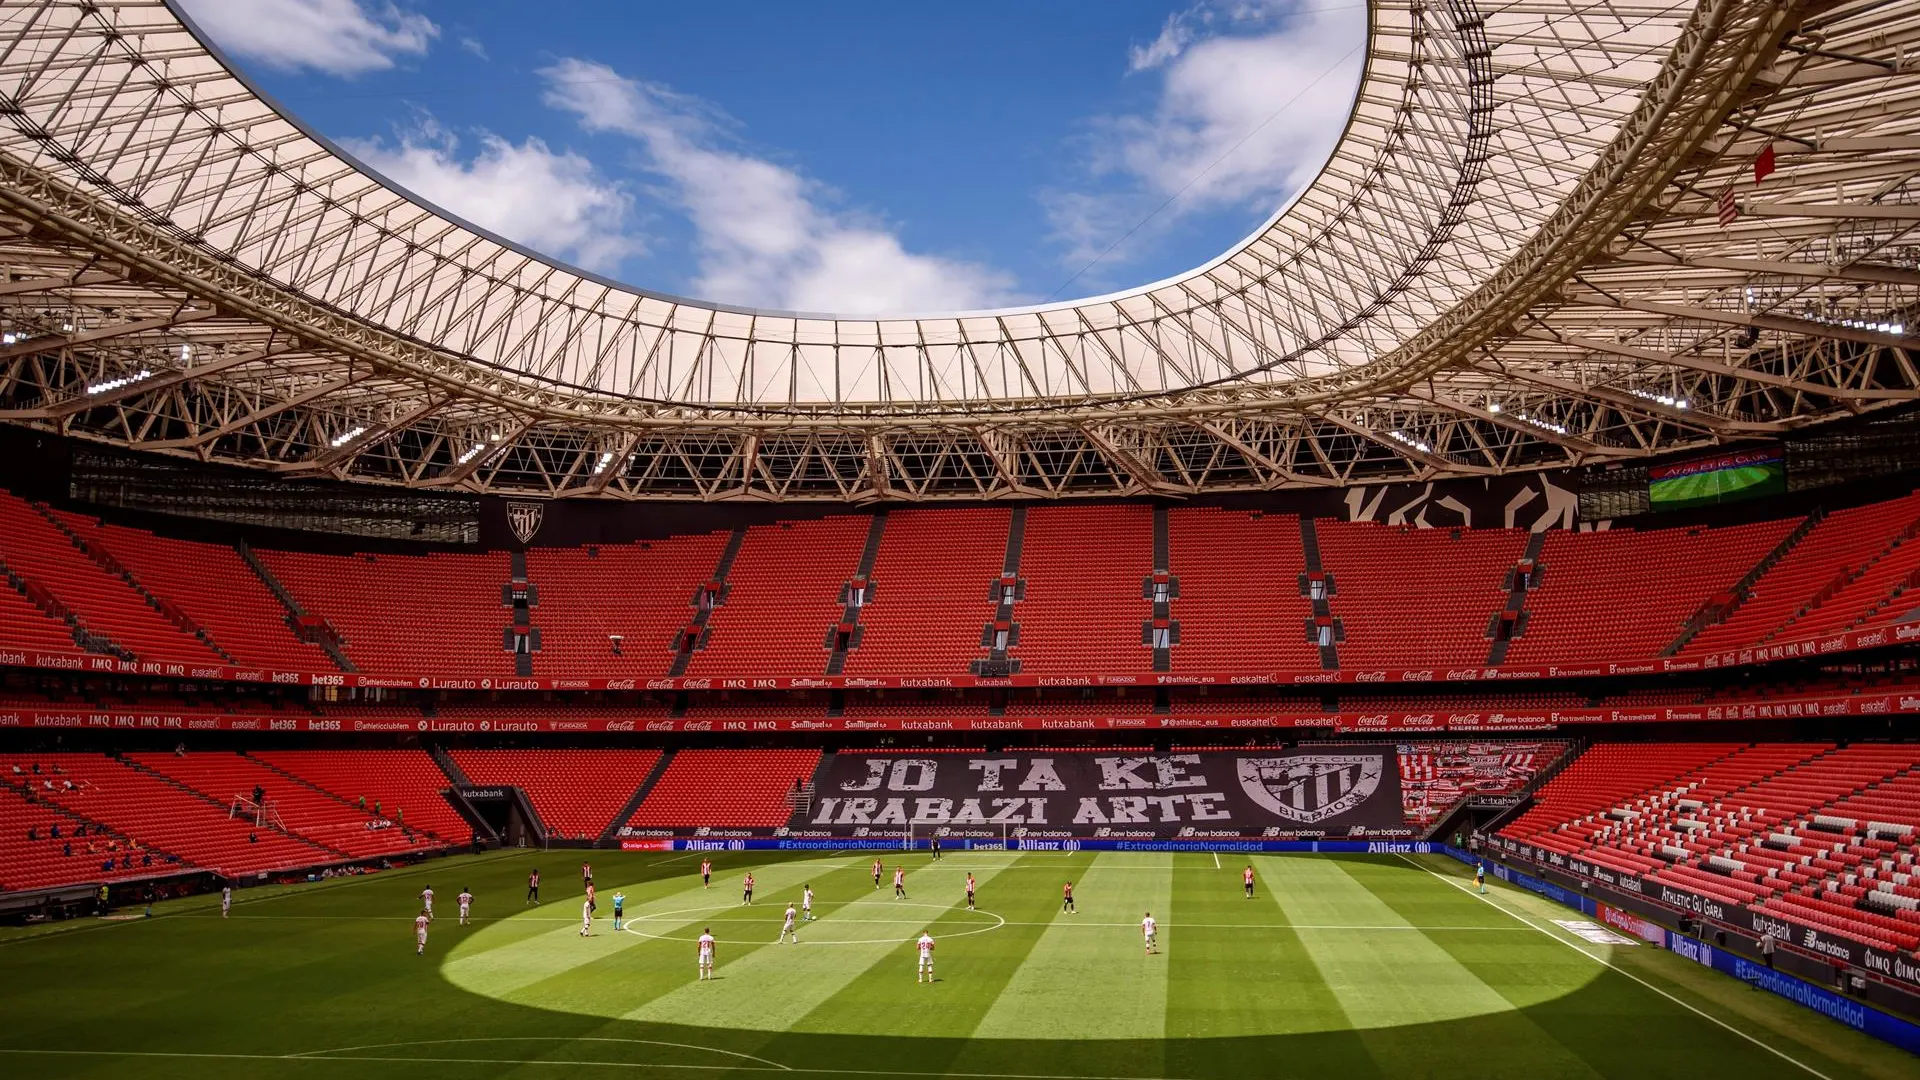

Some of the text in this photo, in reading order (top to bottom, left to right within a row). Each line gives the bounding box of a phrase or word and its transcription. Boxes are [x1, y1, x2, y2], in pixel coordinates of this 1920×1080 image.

[36, 654, 83, 669] kutxabank
[92, 658, 112, 671] IMQ
[118, 661, 138, 673] IMQ
[142, 662, 161, 675] IMQ
[166, 664, 184, 676] IMQ
[1512, 670, 1540, 678] balance
[272, 672, 298, 683] bet365
[312, 674, 344, 685] bet365
[900, 677, 952, 687] kutxabank
[1038, 676, 1091, 686] kutxabank
[433, 678, 476, 689] Lurauto
[495, 680, 538, 690] Lurauto
[722, 680, 747, 688] IMQ
[753, 680, 776, 688] IMQ
[34, 713, 81, 726] kutxabank
[89, 715, 109, 726] IMQ
[115, 715, 135, 727] IMQ
[140, 716, 159, 728] IMQ
[164, 717, 182, 728] IMQ
[902, 720, 953, 729] kutxabank
[971, 719, 1023, 728] kutxabank
[1042, 719, 1095, 728] kutxabank
[1517, 715, 1545, 723] balance
[270, 720, 296, 730] bet365
[309, 720, 340, 730] bet365
[431, 721, 474, 731] Lurauto
[494, 722, 538, 731] Lurauto
[723, 722, 747, 730] IMQ
[753, 722, 776, 730] IMQ
[840, 754, 1208, 792] JO TA KE
[463, 789, 504, 798] kutxabank
[811, 792, 1231, 824] IRABAZI ARTE
[1280, 802, 1346, 821] BILBAO
[685, 840, 724, 850] Allianz
[778, 840, 917, 850] #ExtraordinariaNormalidad
[1018, 840, 1058, 850] Allianz
[1117, 842, 1263, 851] #ExtraordinariaNormalidad
[1368, 842, 1411, 853] Allianz
[1662, 886, 1690, 909] ATHLETIC
[1704, 898, 1723, 920] GARA
[1753, 914, 1790, 941] kutxabank
[1672, 932, 1698, 961] Allianz
[1816, 940, 1826, 951] new
[1827, 941, 1850, 960] balance
[1872, 955, 1890, 975] IMQ
[1903, 964, 1920, 984] IMQ
[1736, 959, 1864, 1028] #ExtraordinariaNormalidad
